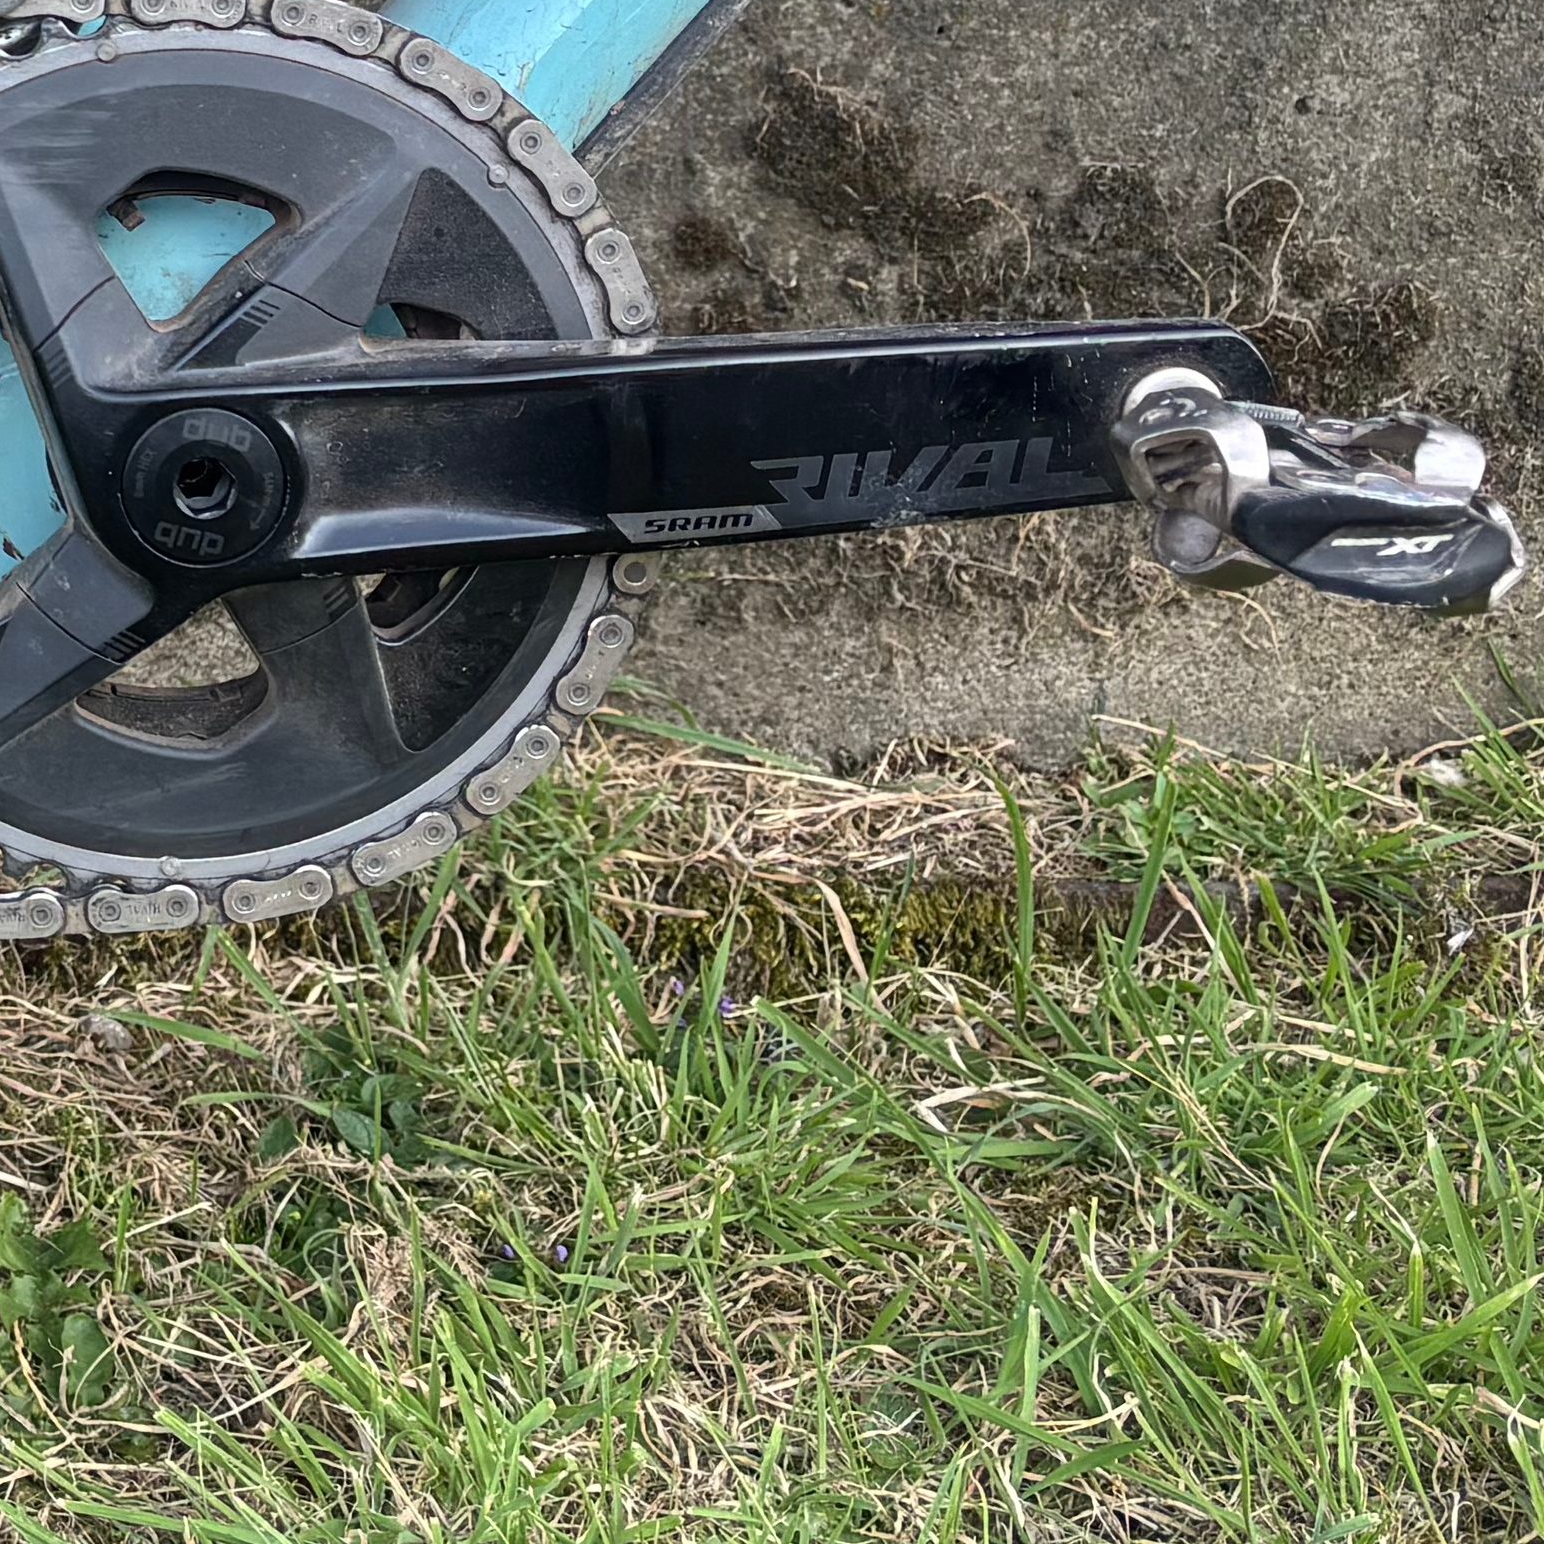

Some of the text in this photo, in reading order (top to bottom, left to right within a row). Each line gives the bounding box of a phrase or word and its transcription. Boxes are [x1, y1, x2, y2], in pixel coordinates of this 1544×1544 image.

[751, 436, 1111, 505] RIVAL
[643, 513, 754, 535] SRAM
[1376, 532, 1456, 558] XT
